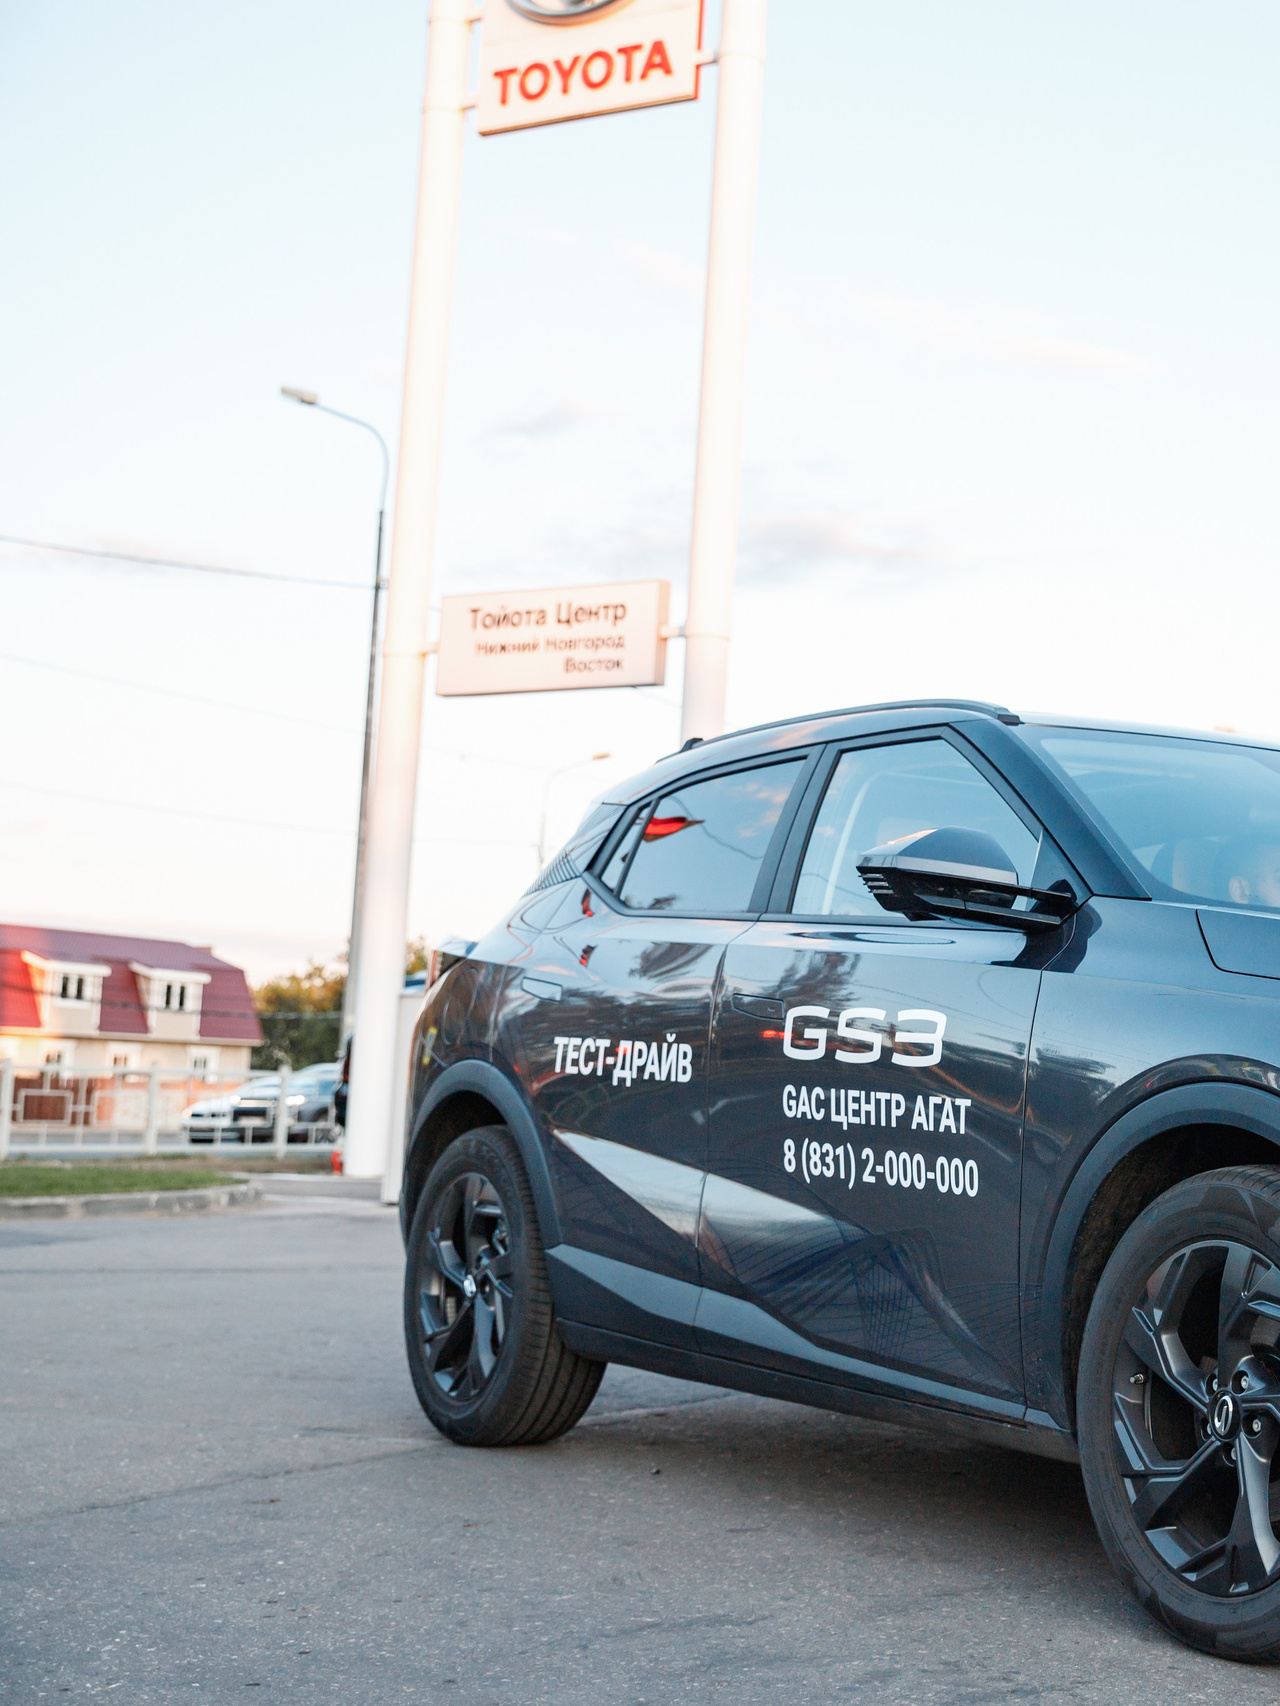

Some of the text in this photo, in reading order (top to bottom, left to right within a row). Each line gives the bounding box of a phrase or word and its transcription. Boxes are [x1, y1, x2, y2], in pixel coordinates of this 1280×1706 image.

[494, 41, 673, 105] TOYOTA
[470, 601, 626, 630] Тойота Центр
[564, 656, 624, 673] Восток
[553, 1034, 693, 1087] ТЕСТ-ДРАЙВ
[783, 1005, 948, 1067] GS3
[782, 1084, 972, 1135] GAC ЦЕНТР АГАТ
[783, 1137, 979, 1198] 8 (831) 2-000-000
